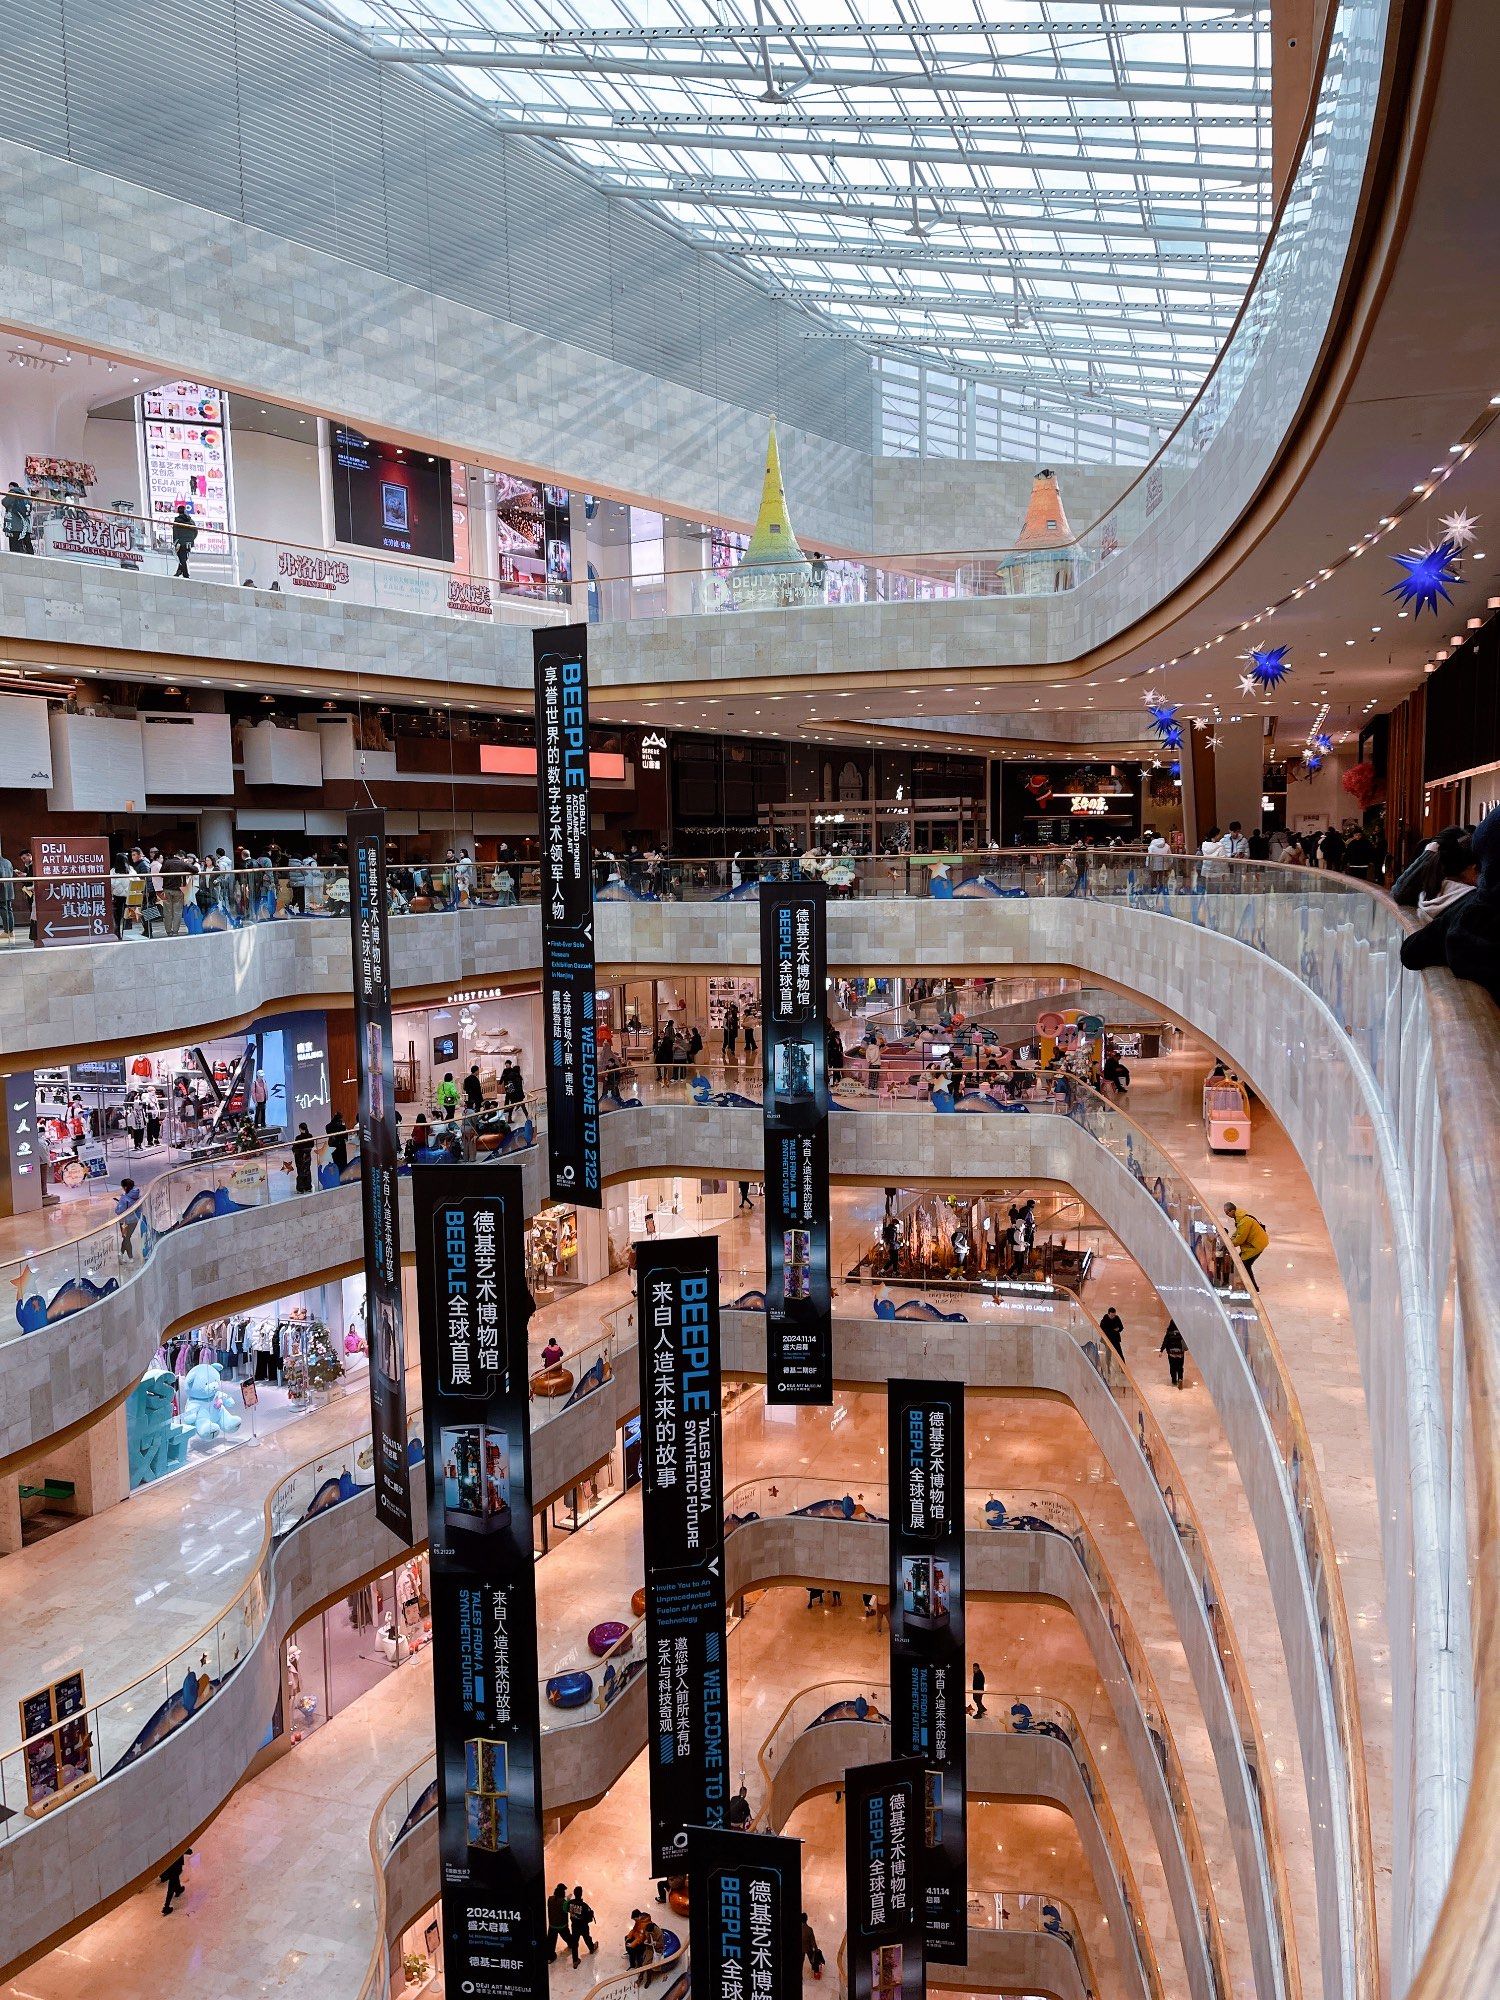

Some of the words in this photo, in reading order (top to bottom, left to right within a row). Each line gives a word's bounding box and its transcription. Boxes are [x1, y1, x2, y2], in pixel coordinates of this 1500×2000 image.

[151, 478, 168, 486] DEJI
[168, 479, 185, 487] ART
[151, 485, 178, 493] STORE
[62, 517, 131, 551] 雷诺阿
[278, 552, 350, 584] 弗洛伊德
[732, 576, 763, 589] DEJI
[768, 572, 796, 586] ART
[447, 580, 492, 607] 欧姬芙
[562, 663, 585, 787] BEEPLE
[544, 666, 565, 920] 享誉世界的数字艺术领军人物
[566, 794, 571, 804] IN
[572, 794, 580, 840] ACCLAIMED
[579, 794, 587, 836] GLOBALLY
[41, 843, 66, 854] DEJI
[42, 855, 61, 864] ART
[63, 854, 104, 864] MUSEUM
[573, 841, 581, 879] PIONEER
[42, 864, 104, 875] 德基艺术博物馆
[45, 881, 105, 901] 大师油画
[62, 899, 106, 919] 真迹展
[368, 848, 382, 984] 德基艺术博物馆
[93, 918, 110, 935] 8F
[796, 908, 810, 1006] 德基艺术博物馆
[448, 991, 476, 1003] FIRST
[581, 1026, 596, 1115] WELCOME
[584, 1120, 597, 1144] TO
[802, 1139, 813, 1220] 来自人造未来的故事
[473, 1210, 499, 1370] 德基艺术博物馆
[680, 1278, 710, 1413] BEEPLE
[782, 1335, 817, 1343] 2024.11.14
[652, 1281, 677, 1489] 来自人造未来的故事
[699, 1417, 710, 1459] TALES
[685, 1420, 697, 1494] SYNTHETIC
[929, 1411, 945, 1519] 德基艺术博物馆
[700, 1462, 711, 1500] FROM
[687, 1495, 699, 1548] FUTURE
[701, 1502, 711, 1512] A
[656, 1583, 676, 1591] Invite
[460, 1590, 471, 1652] SYNTHETIC
[472, 1591, 481, 1625] TALES
[657, 1616, 698, 1626] Technology
[703, 1601, 717, 1609] and
[474, 1628, 483, 1661] FROM
[492, 1590, 511, 1723] 来自人造未来的故事
[462, 1654, 472, 1700] FUTURE
[475, 1662, 483, 1670] A
[657, 1639, 673, 1733] 艺术与科技奇观
[674, 1637, 690, 1757] 邀您步入前所未有的
[703, 1669, 722, 1768] WELCOME
[912, 1712, 920, 1744] FUTURE
[935, 1669, 946, 1760] 来自人造未来的故事
[705, 1772, 723, 1799] TO
[889, 1794, 906, 1910] 德基艺术博物馆
[466, 1907, 521, 1921] 2024.11.14
[467, 1920, 509, 1933] 盛大启幕
[469, 1956, 524, 1970] 德基二期8F
[504, 1985, 532, 1993] MUSEUM
